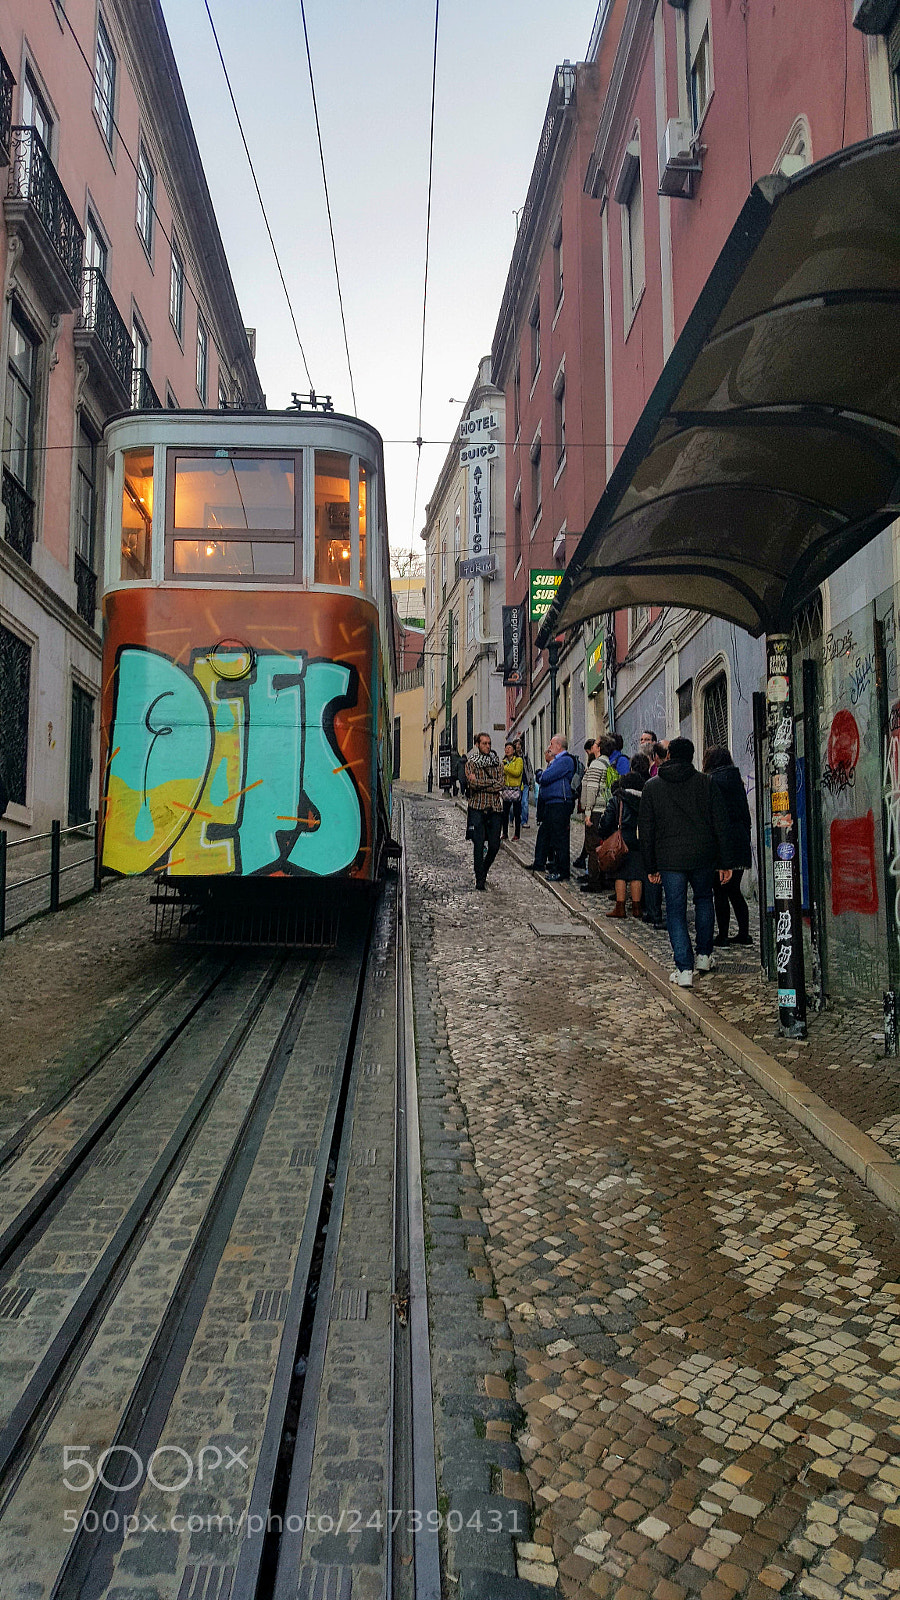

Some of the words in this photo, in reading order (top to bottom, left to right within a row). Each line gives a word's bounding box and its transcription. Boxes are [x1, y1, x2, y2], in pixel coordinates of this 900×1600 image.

[461, 415, 496, 436] HOTEL
[533, 590, 557, 600] SUB
[511, 633, 518, 644] do
